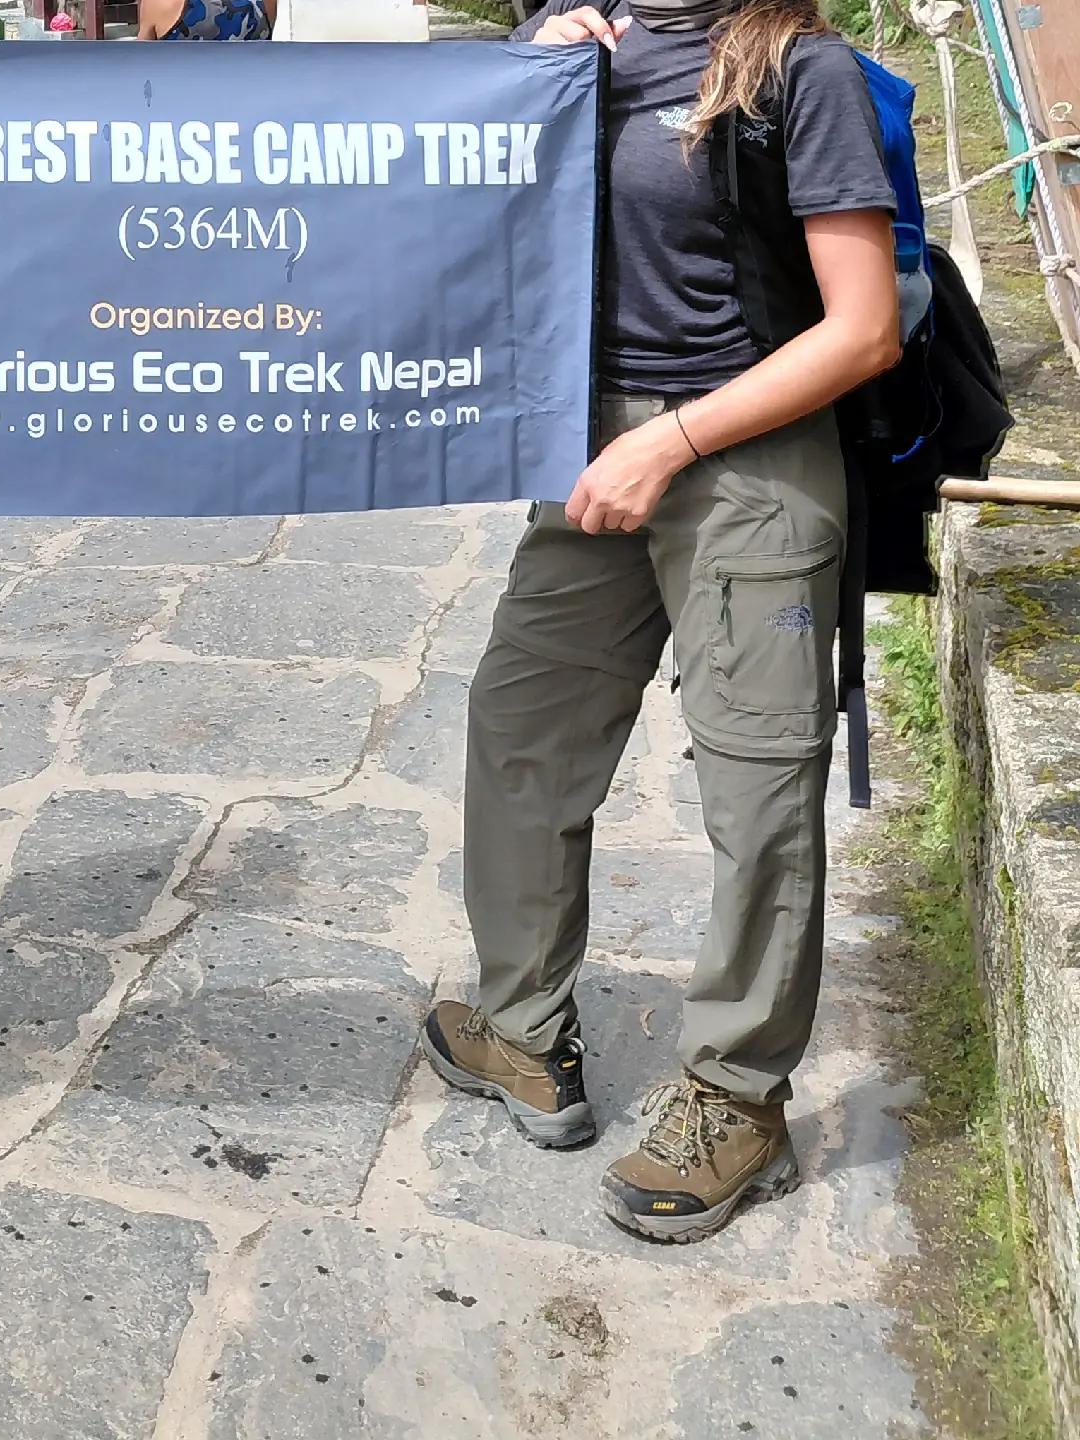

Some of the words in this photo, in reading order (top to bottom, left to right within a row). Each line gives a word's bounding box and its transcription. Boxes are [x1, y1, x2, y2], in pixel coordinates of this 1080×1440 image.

[111, 120, 242, 185] BASE
[253, 121, 407, 185] CAMP
[415, 121, 543, 186] TREK
[118, 205, 308, 262] (5364M)
[89, 302, 264, 336] Organized
[275, 304, 323, 336] By:
[132, 351, 223, 393] Eco
[239, 351, 344, 393] Trek
[360, 346, 482, 397] Nepal
